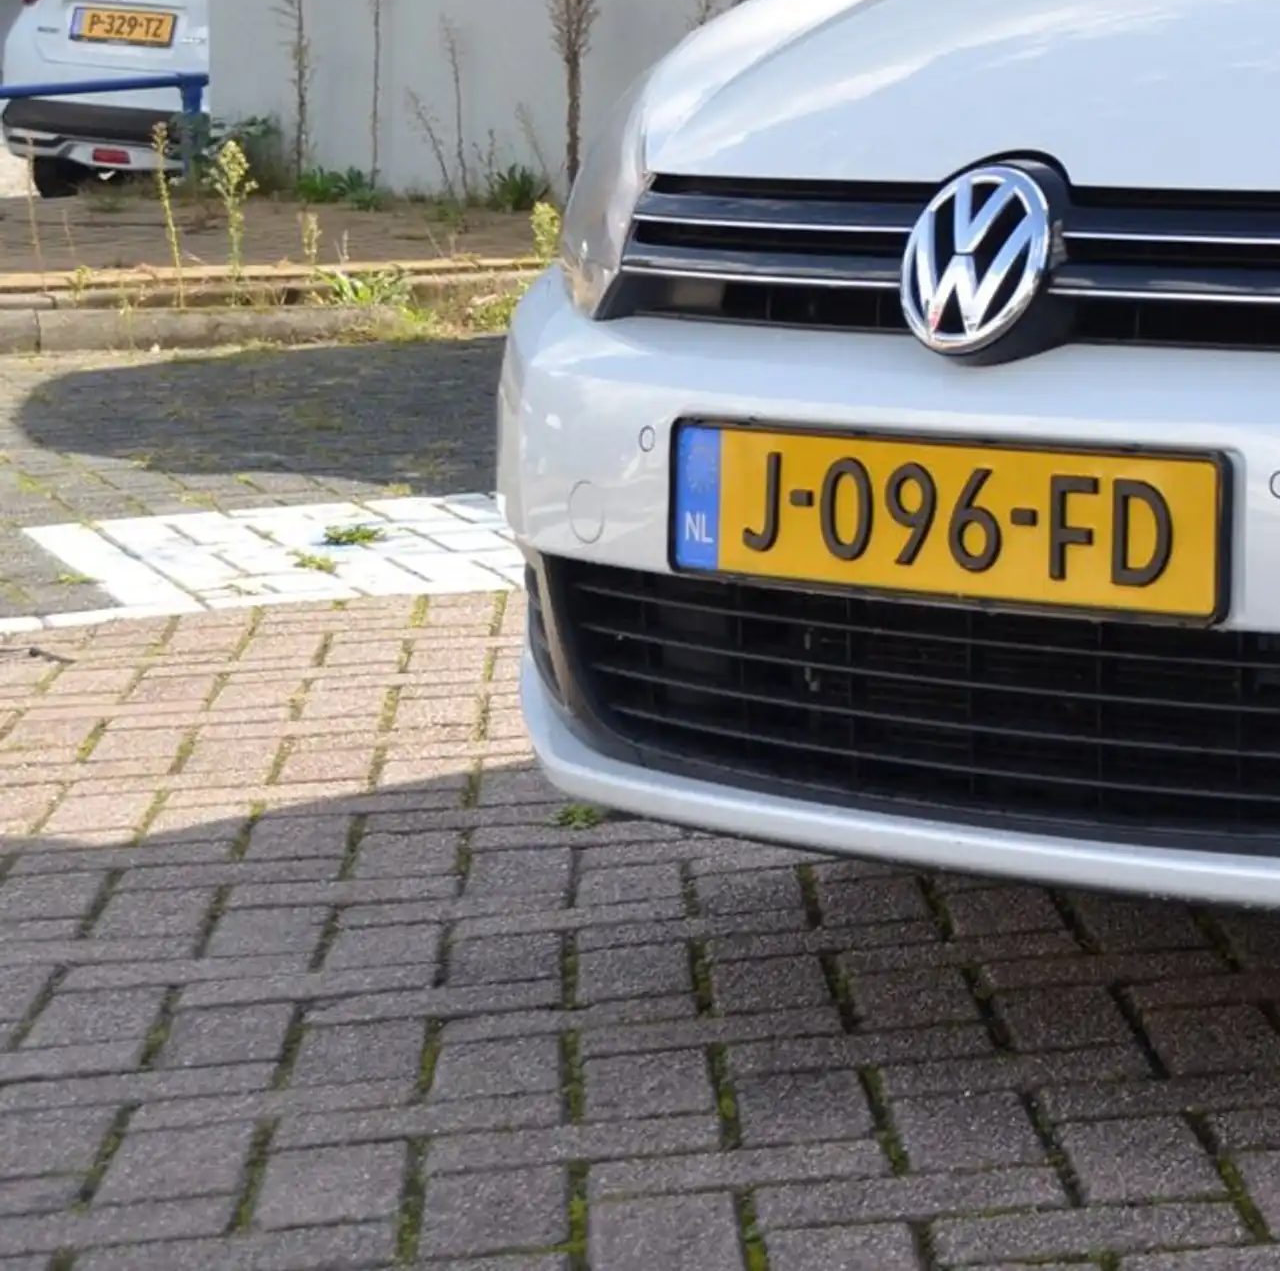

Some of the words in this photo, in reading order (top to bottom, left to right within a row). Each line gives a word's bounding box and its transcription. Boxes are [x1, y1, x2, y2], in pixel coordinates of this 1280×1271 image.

[88, 12, 165, 39] P-329-TZ
[684, 511, 714, 544] NL
[742, 451, 1173, 587] J-096-FD
